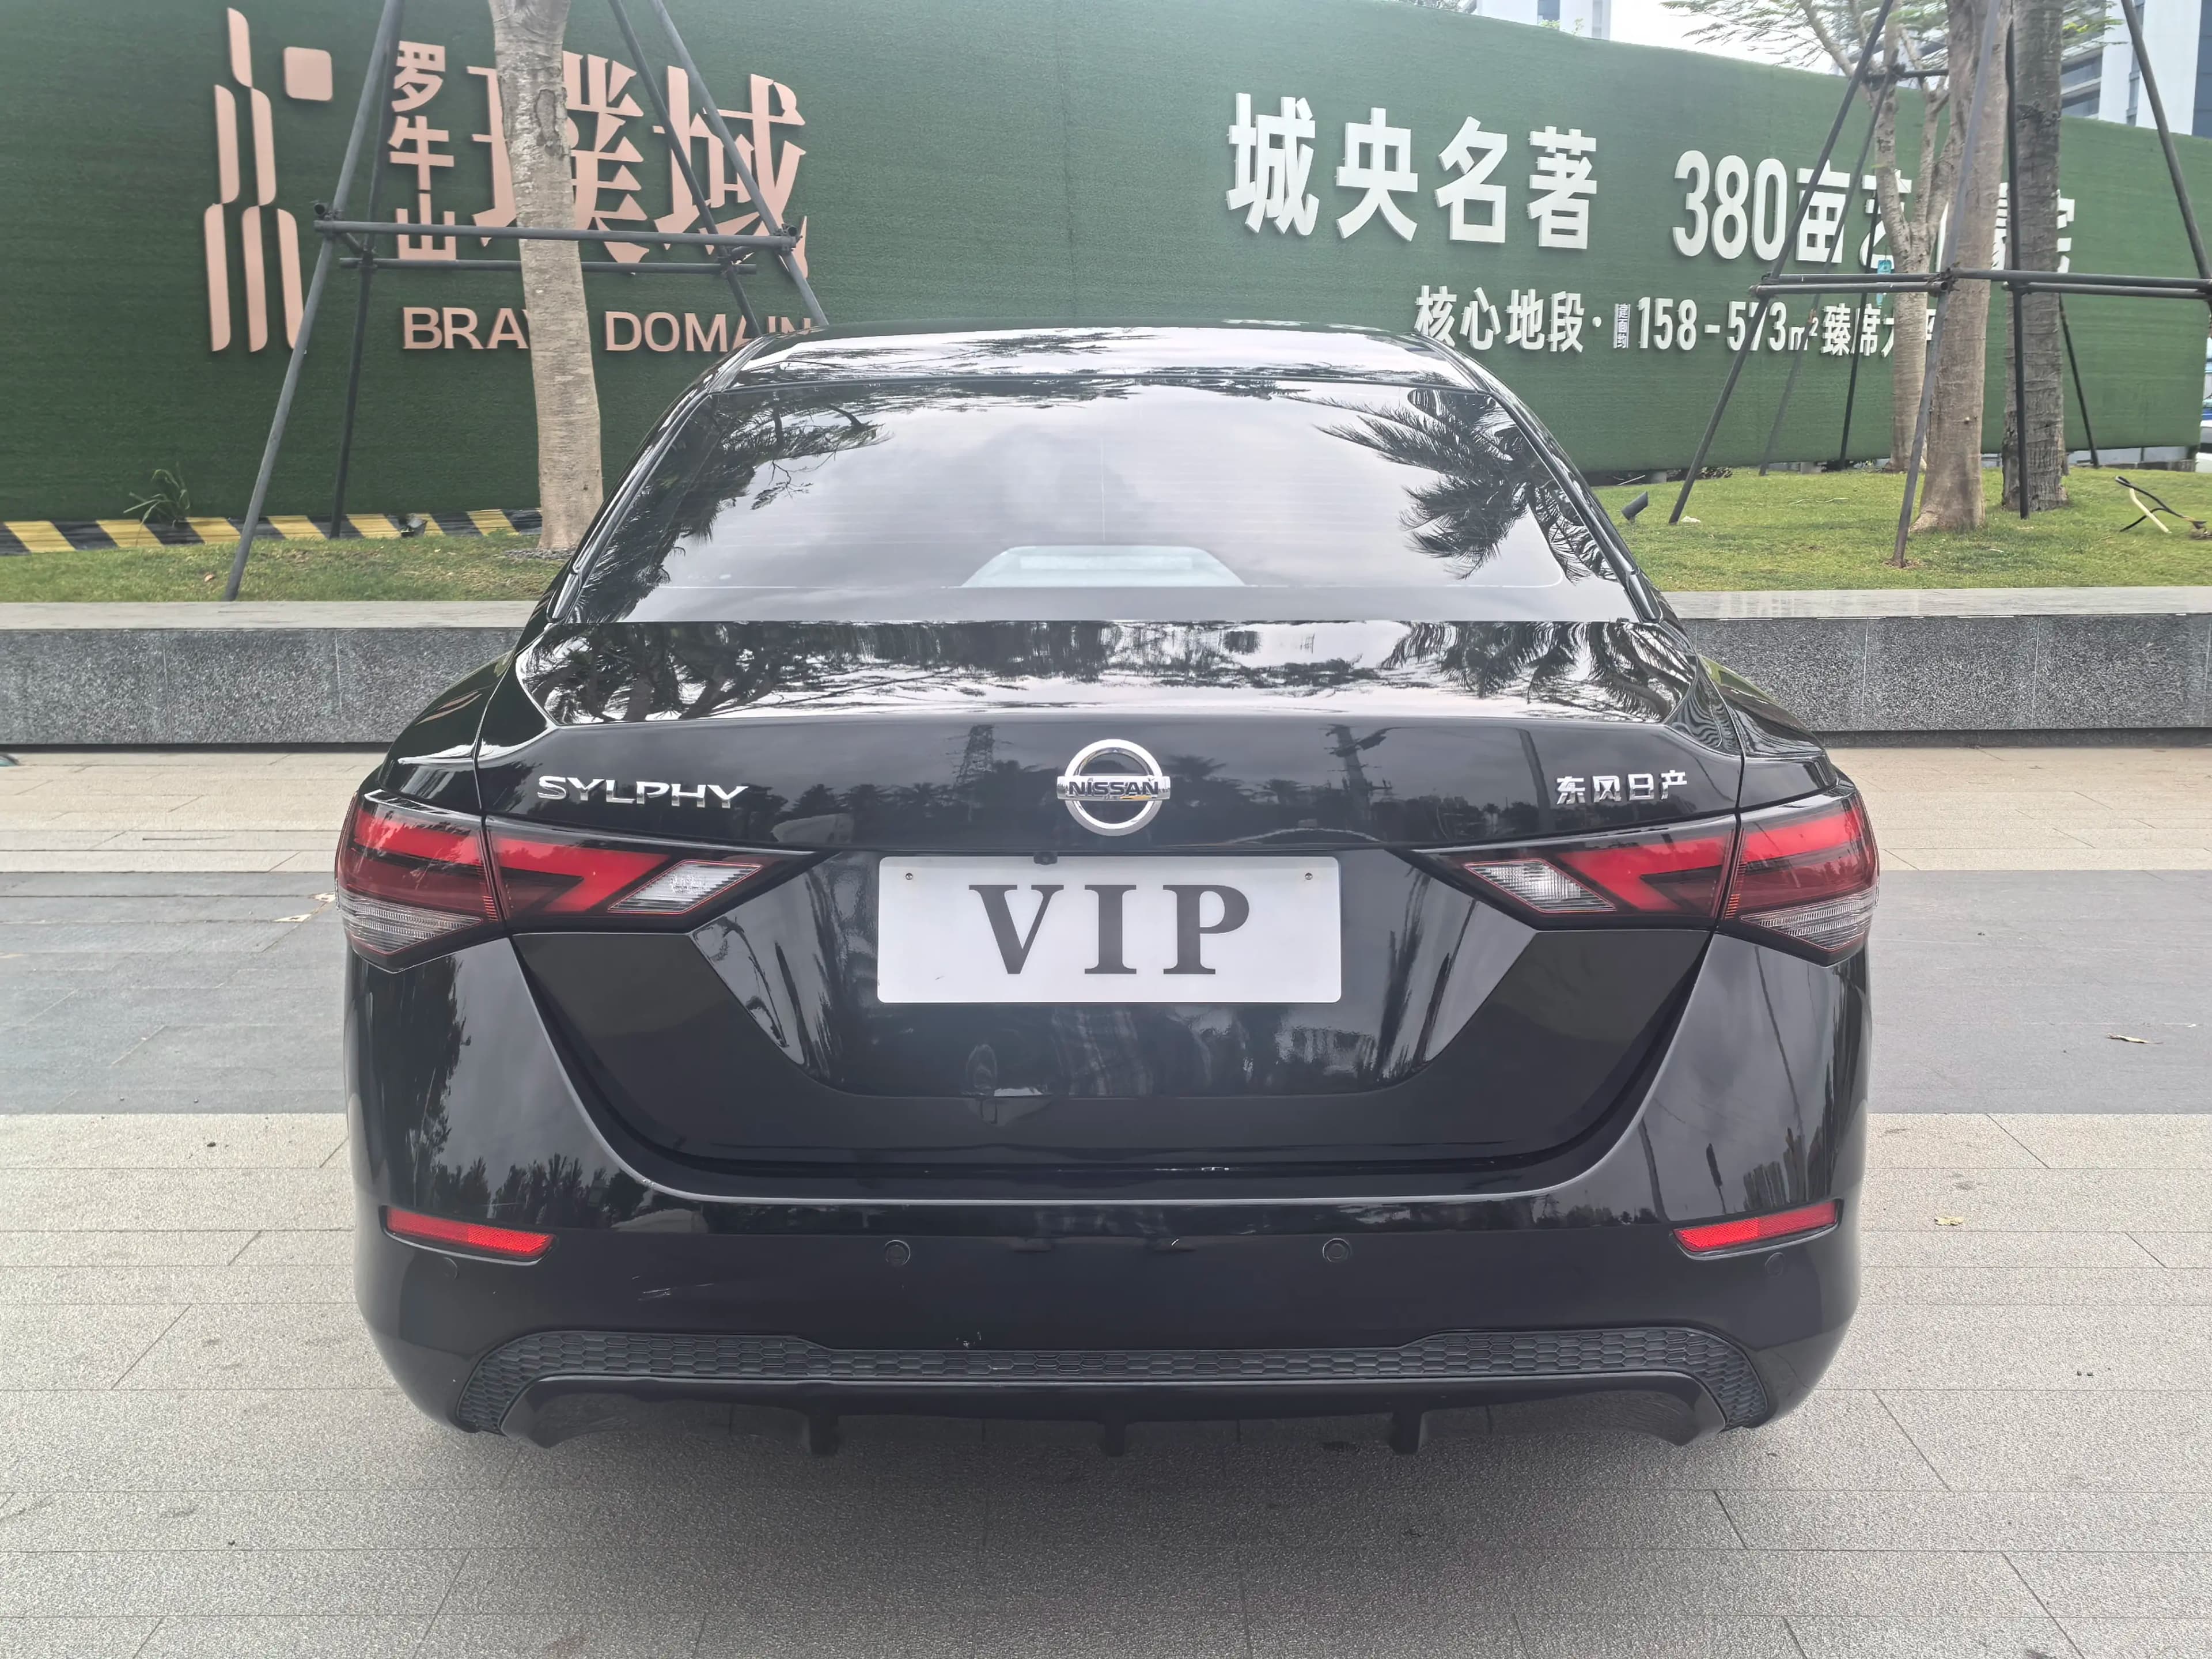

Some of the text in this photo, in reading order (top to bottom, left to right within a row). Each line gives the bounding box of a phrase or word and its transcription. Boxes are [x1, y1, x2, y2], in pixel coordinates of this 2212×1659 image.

[387, 40, 457, 261] 罗牛山
[1226, 92, 1597, 249] 城央名著
[403, 306, 528, 350] BRA
[537, 775, 749, 808] SYLPHY
[1069, 781, 1159, 795] NISSAN
[1556, 770, 1688, 805] 东风日产
[968, 884, 1250, 975] VIP
